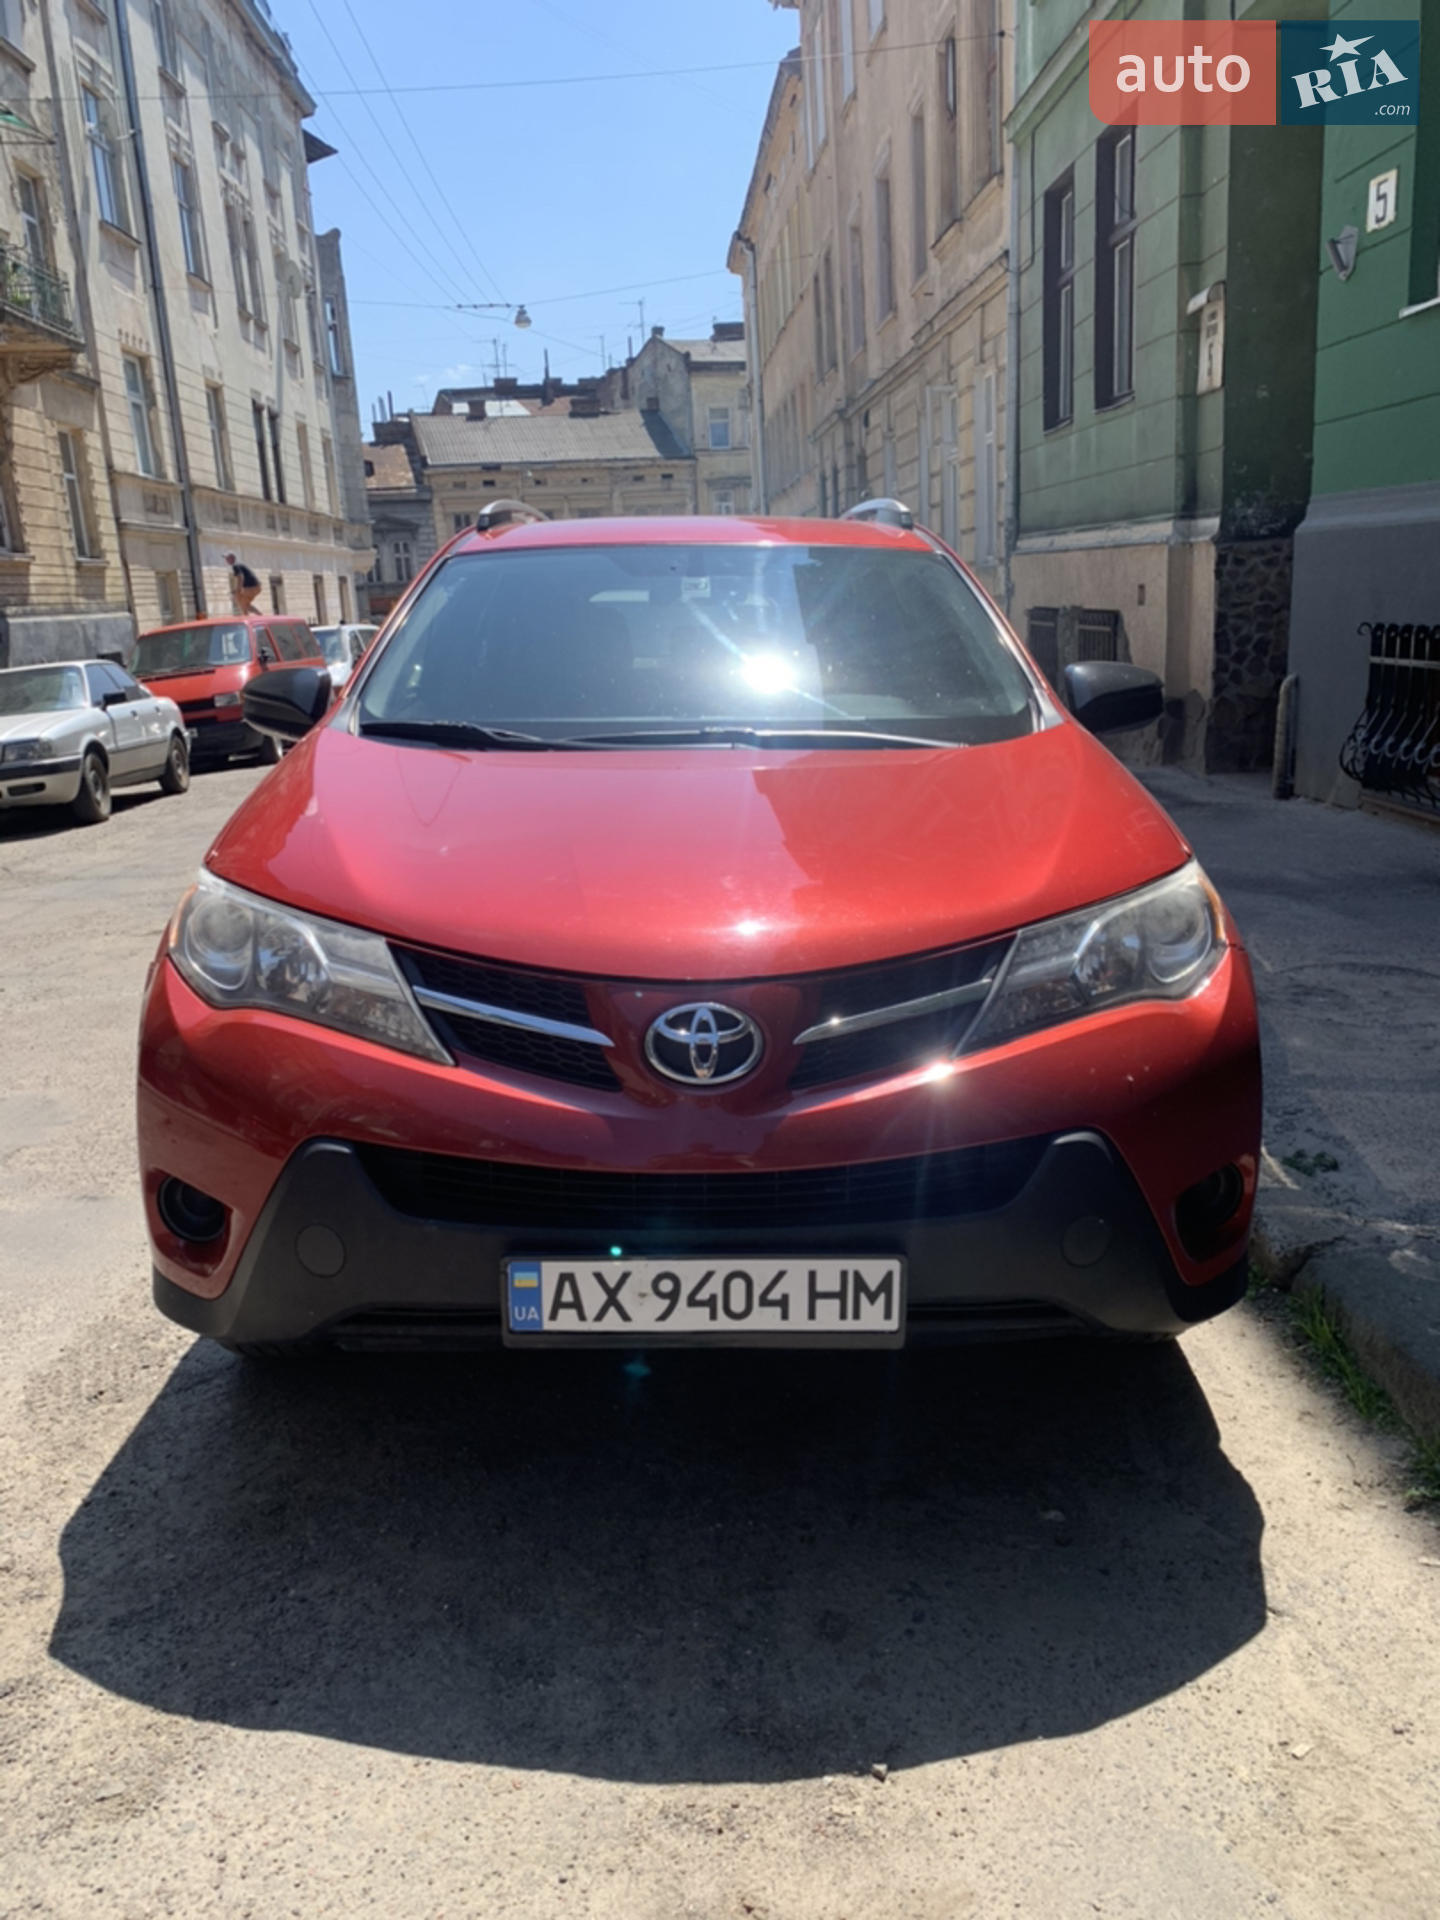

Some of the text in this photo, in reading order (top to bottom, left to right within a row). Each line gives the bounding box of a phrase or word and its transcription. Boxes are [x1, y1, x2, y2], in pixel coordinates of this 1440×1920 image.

[1375, 178, 1389, 225] 5
[514, 1305, 540, 1321] UA
[548, 1269, 893, 1322] AX 9404 HM
